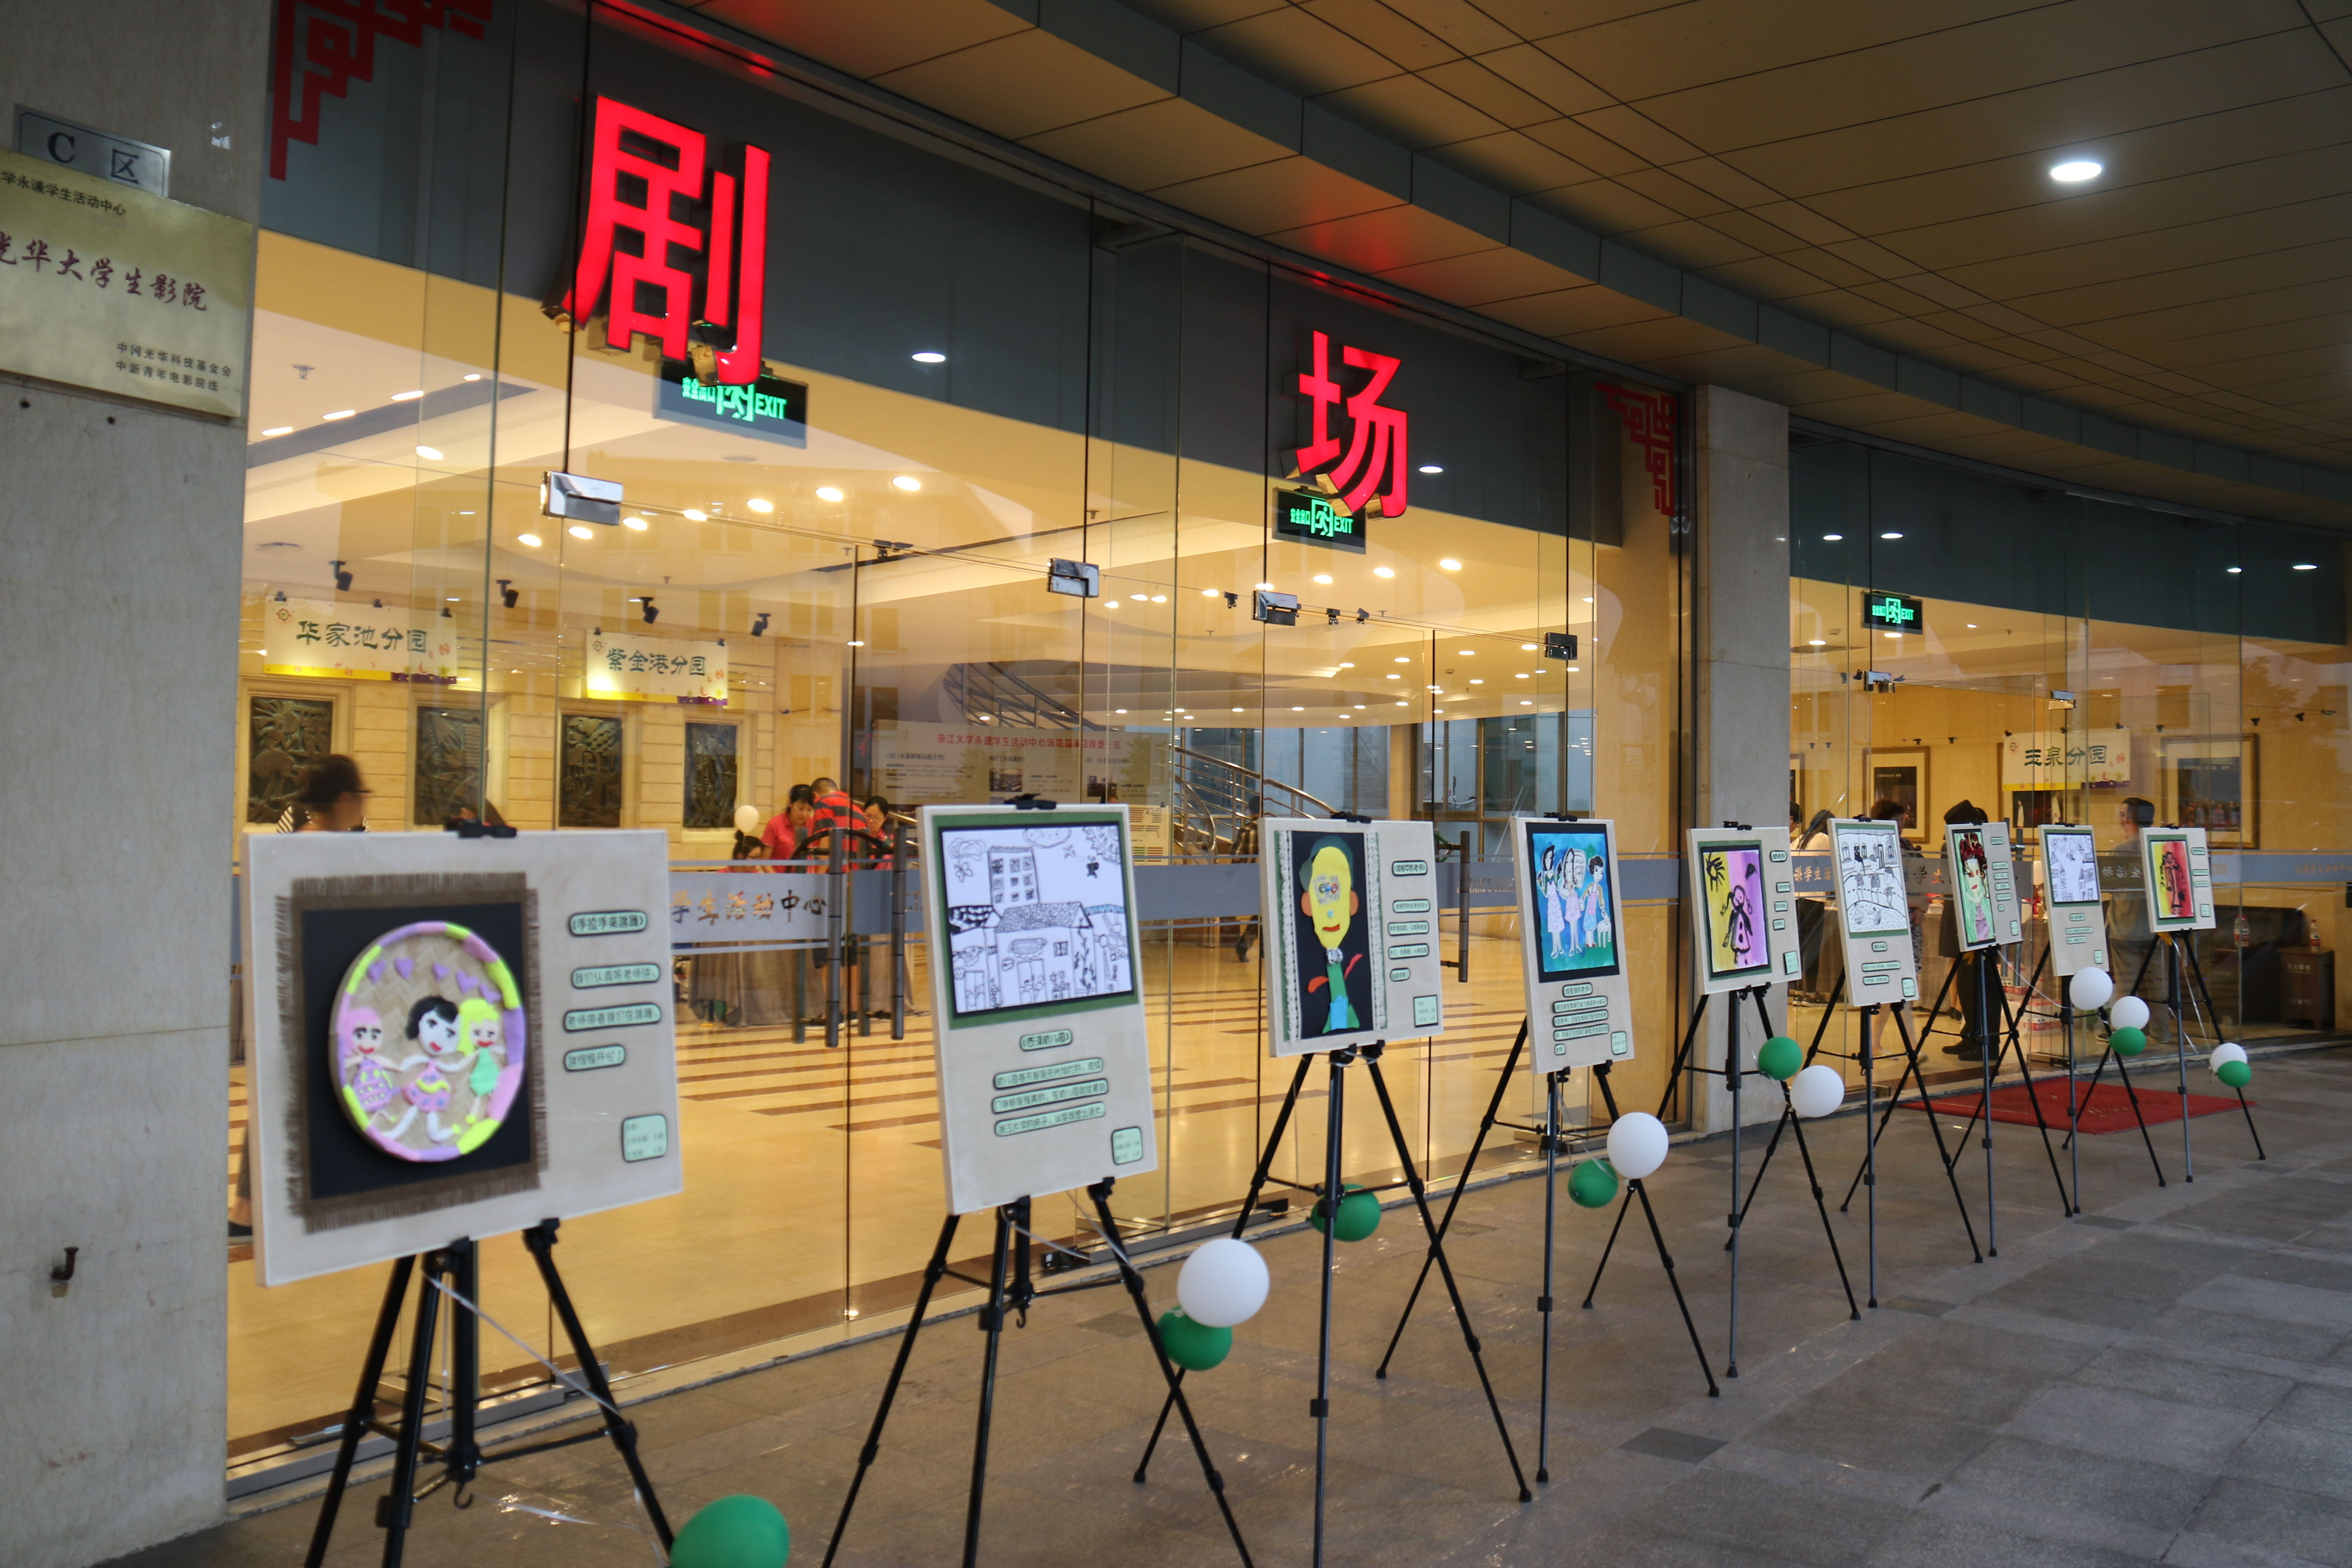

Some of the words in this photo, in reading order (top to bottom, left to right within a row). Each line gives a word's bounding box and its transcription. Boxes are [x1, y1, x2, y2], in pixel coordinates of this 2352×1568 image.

[47, 132, 75, 163] C
[110, 148, 139, 184] 区
[561, 94, 771, 385] 剧
[1296, 331, 1408, 518] 场
[117, 342, 231, 377] 中国光华科技基金会
[116, 360, 218, 392] 中新青年电影院线
[755, 392, 787, 420] EXIT
[1290, 508, 1311, 526] 安全出口
[1334, 516, 1353, 534] EXIT
[1901, 608, 1914, 620] EXIT
[296, 620, 427, 653] 华家池分园
[606, 647, 705, 676] 紫金港分园
[2024, 745, 2107, 766] 玉泉分园
